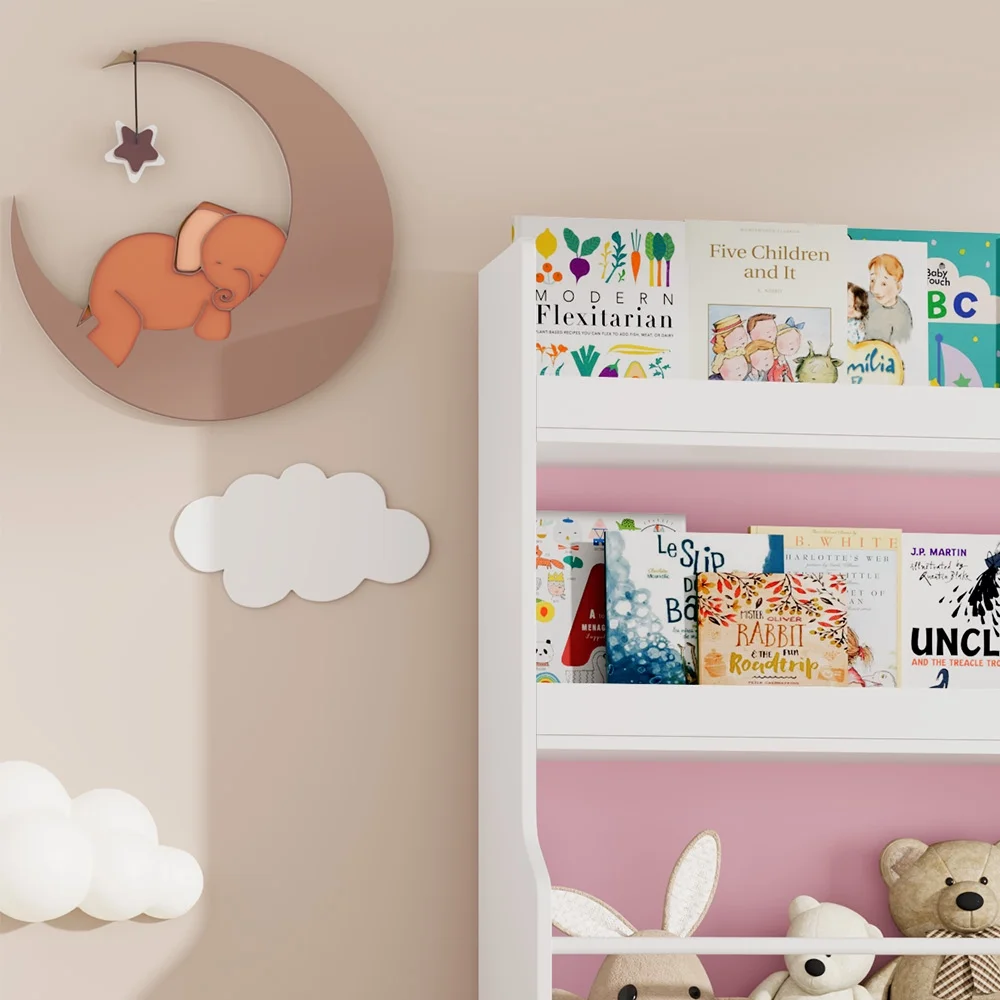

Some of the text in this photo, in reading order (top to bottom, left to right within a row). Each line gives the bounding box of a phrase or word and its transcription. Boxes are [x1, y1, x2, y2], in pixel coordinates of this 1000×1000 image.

[709, 244, 830, 261] Five Children
[744, 265, 796, 280] and It
[927, 268, 948, 279] Baby
[927, 277, 951, 286] ouch
[536, 289, 673, 305] MODERN
[536, 304, 673, 328] Flexitarian
[657, 534, 677, 558] Le
[820, 536, 898, 549] WHITE
[910, 547, 967, 557] J.P. MARTIN
[740, 610, 764, 619] MISTER
[736, 621, 806, 648] RABBIT
[729, 652, 819, 679] Roadtrip
[950, 659, 984, 667] TREACLE
